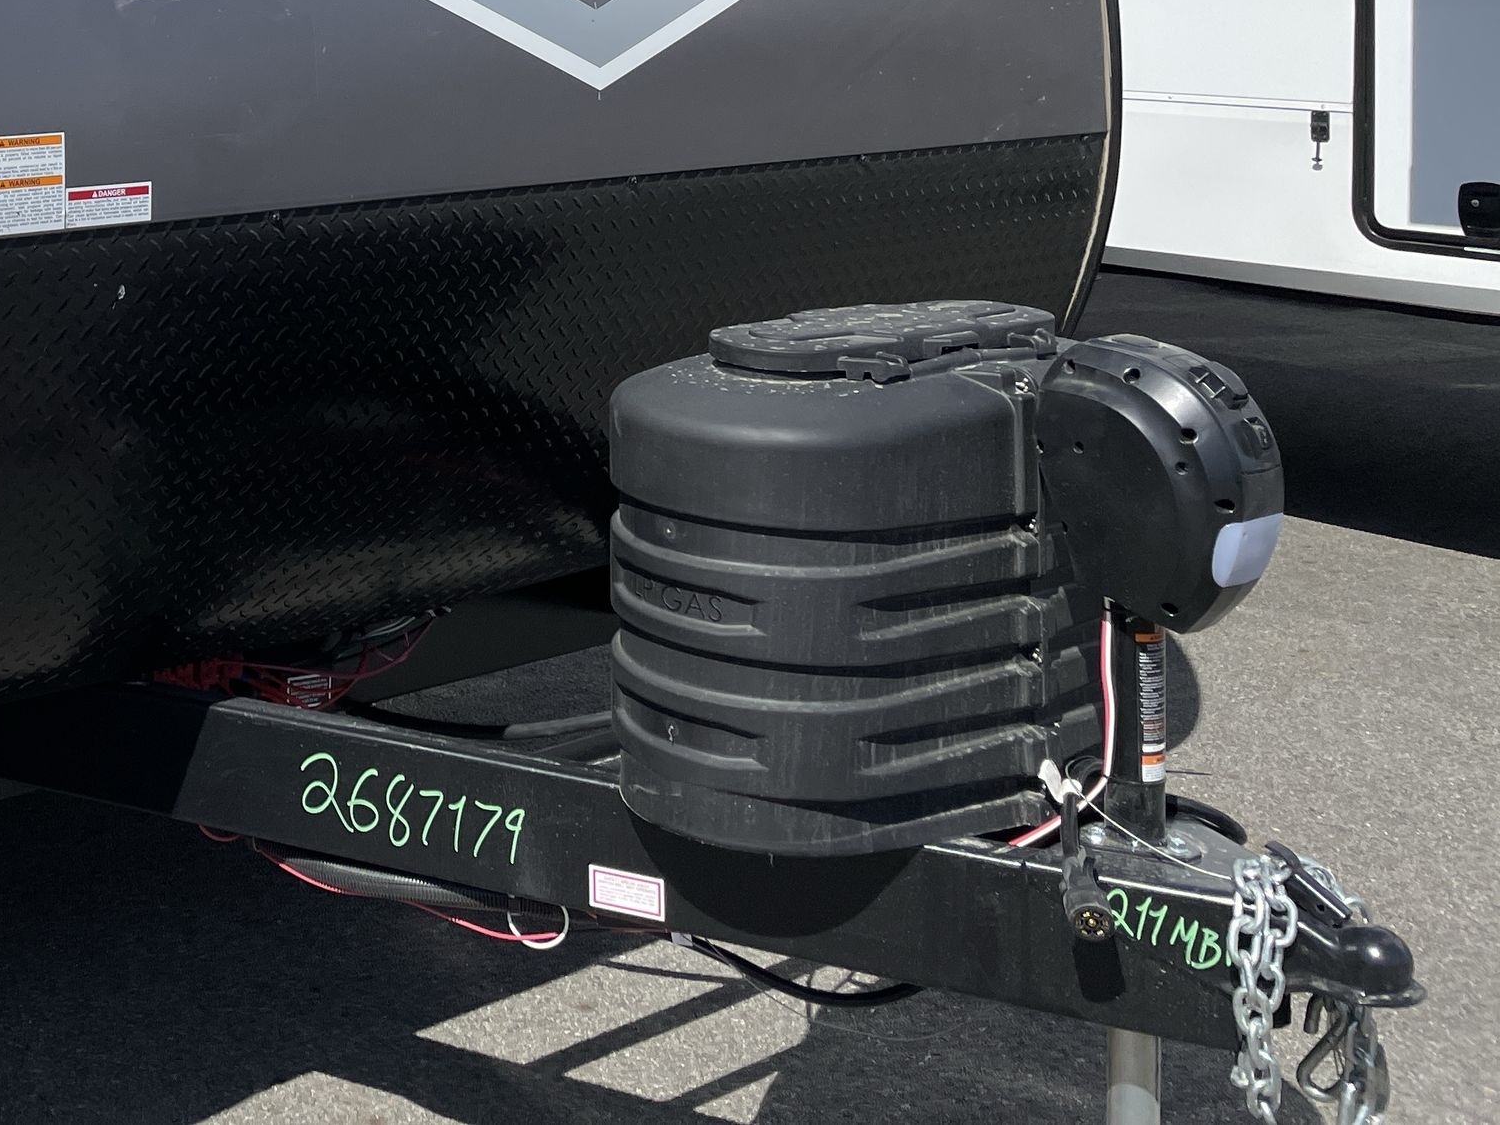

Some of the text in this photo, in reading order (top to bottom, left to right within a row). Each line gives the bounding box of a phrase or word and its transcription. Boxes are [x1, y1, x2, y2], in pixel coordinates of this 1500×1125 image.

[8, 138, 41, 146] WARNING
[8, 178, 41, 187] WARNING
[98, 188, 126, 198] DANGER
[661, 586, 722, 622] GAS
[300, 752, 525, 865] 2687179
[1169, 915, 1232, 970] MB
